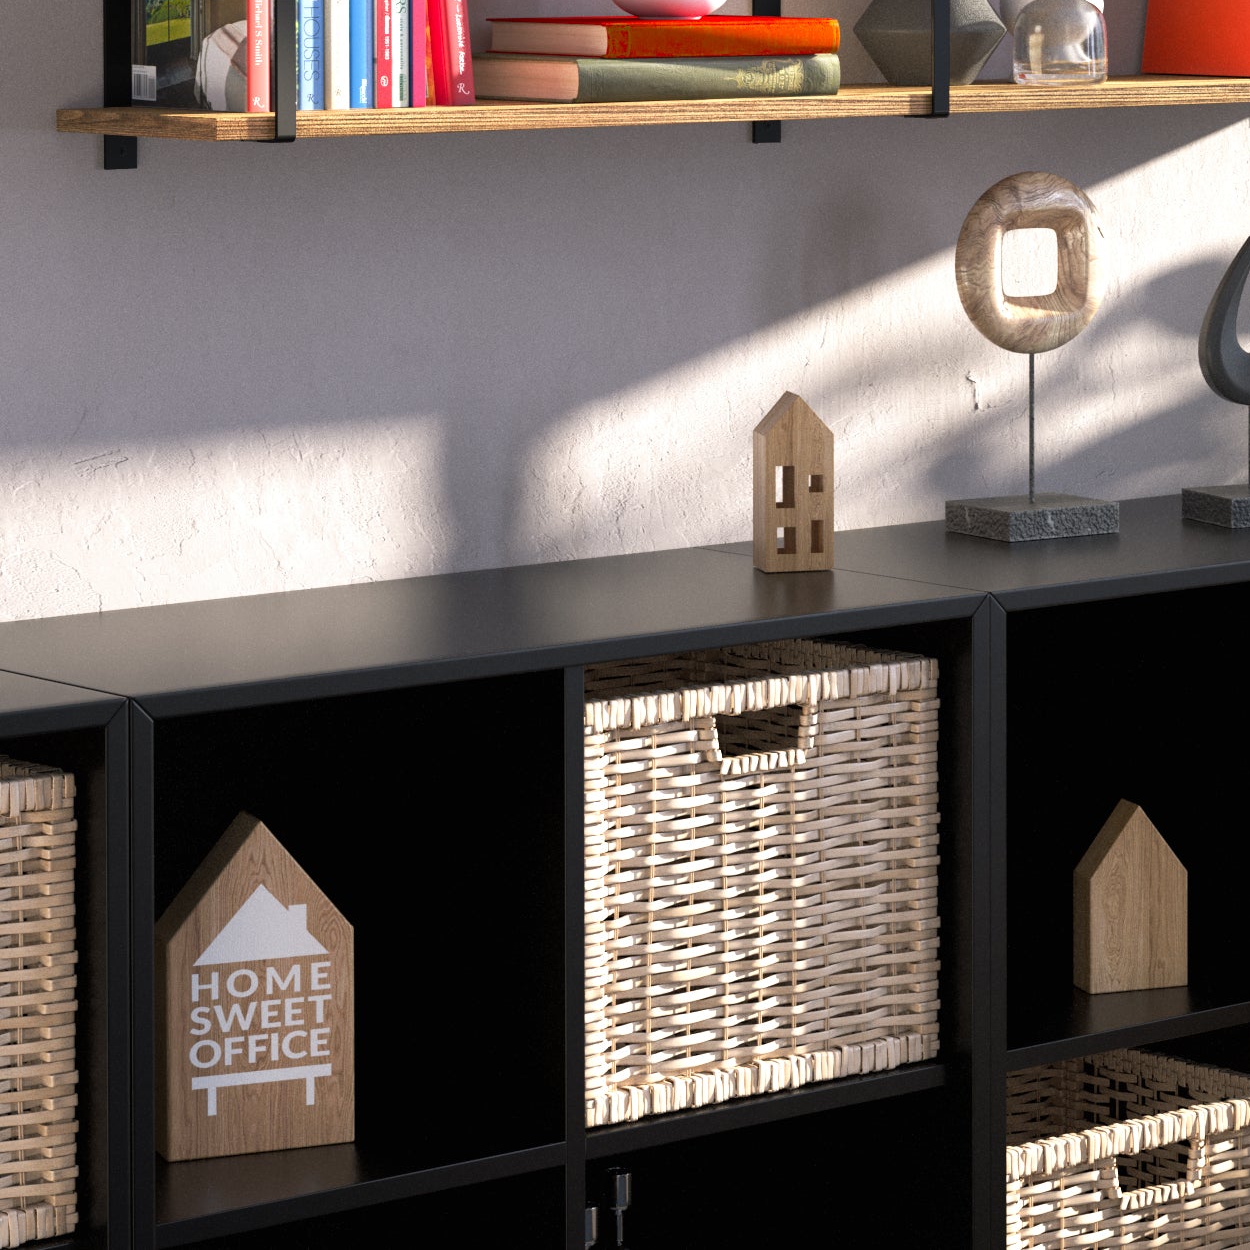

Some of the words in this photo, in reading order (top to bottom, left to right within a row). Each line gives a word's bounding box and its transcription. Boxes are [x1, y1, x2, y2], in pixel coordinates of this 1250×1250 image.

[254, 39, 263, 66] Smith
[303, 6, 320, 82] HOUSES
[191, 961, 331, 1002] HOME
[189, 994, 332, 1036] SWEET
[188, 1027, 331, 1069] OFFICE
